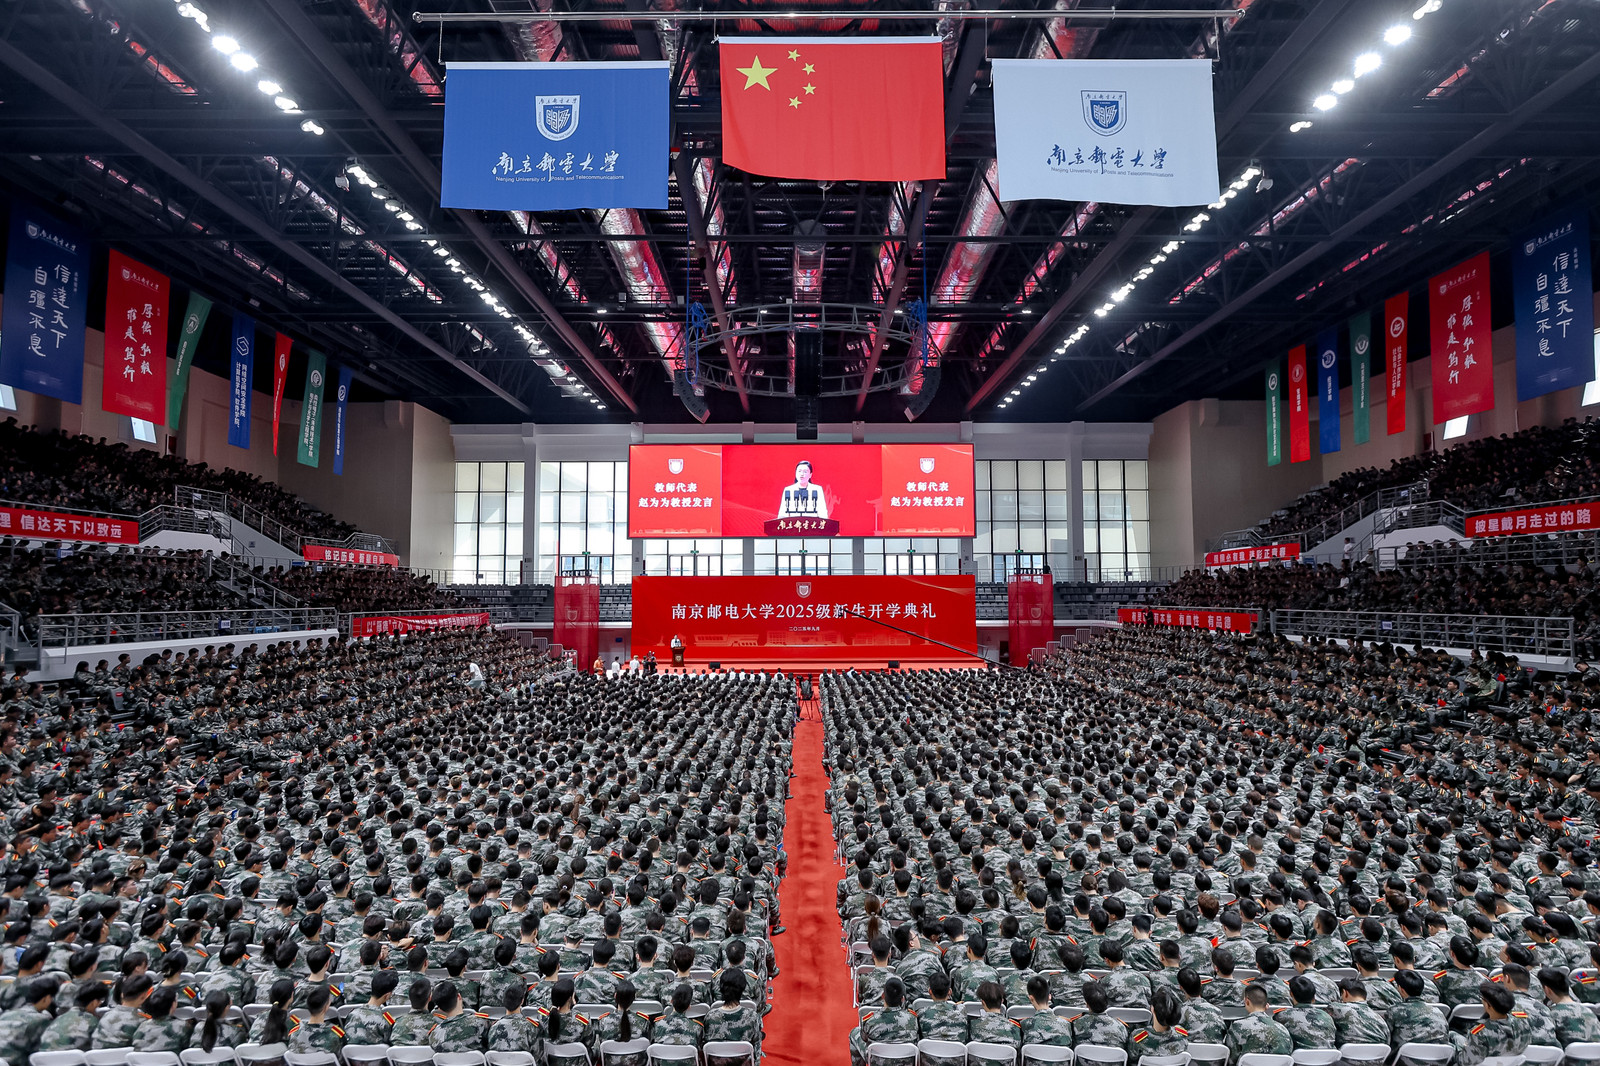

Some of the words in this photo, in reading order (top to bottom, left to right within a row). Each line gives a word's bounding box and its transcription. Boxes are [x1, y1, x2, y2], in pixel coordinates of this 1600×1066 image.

[1051, 166, 1069, 174] Nanjing
[654, 481, 697, 493] 教师代表
[906, 481, 949, 493] 教师代表
[638, 496, 713, 508] 赵为为教授发言
[890, 495, 965, 508] 赵为为教授发言
[20, 514, 122, 538] 信达天下以致远
[1475, 508, 1591, 533] 披星戴月走过的路
[325, 549, 355, 562] 铭记历史
[671, 602, 937, 620] 南京邮电大学2025级新生开学典礼
[1178, 613, 1200, 626] 有血性
[1207, 615, 1231, 629] 有品德
